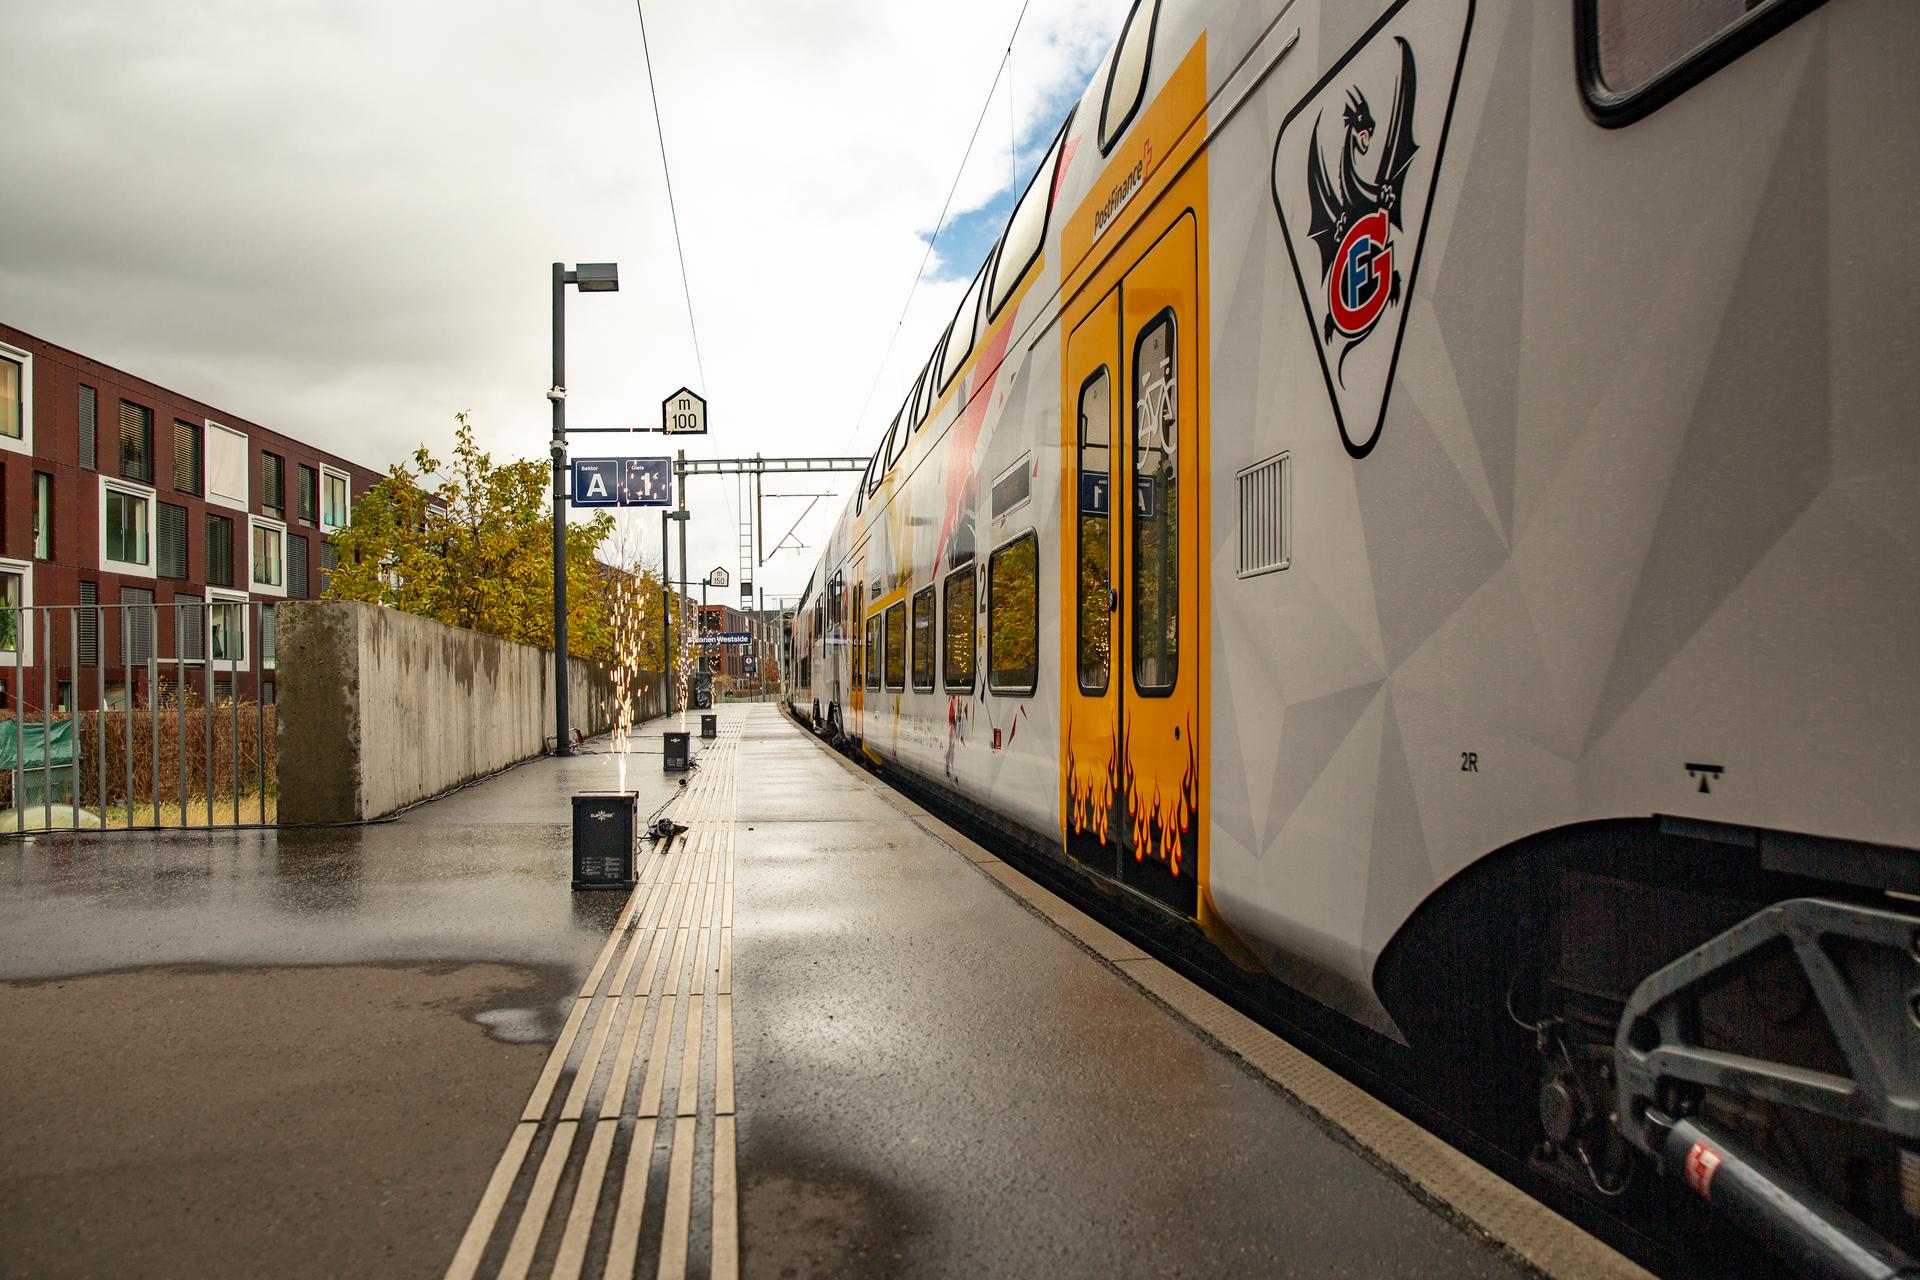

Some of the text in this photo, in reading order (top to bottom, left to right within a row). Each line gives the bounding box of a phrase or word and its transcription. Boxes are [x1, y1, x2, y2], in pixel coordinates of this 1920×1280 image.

[1094, 159, 1143, 236] PostFinance
[679, 399, 690, 410] m
[672, 413, 697, 429] 100
[586, 473, 608, 497] A
[640, 472, 651, 496] 1
[714, 577, 724, 585] 150
[980, 563, 986, 614] 2
[717, 635, 748, 643] Westside
[1461, 752, 1478, 772] 2R
